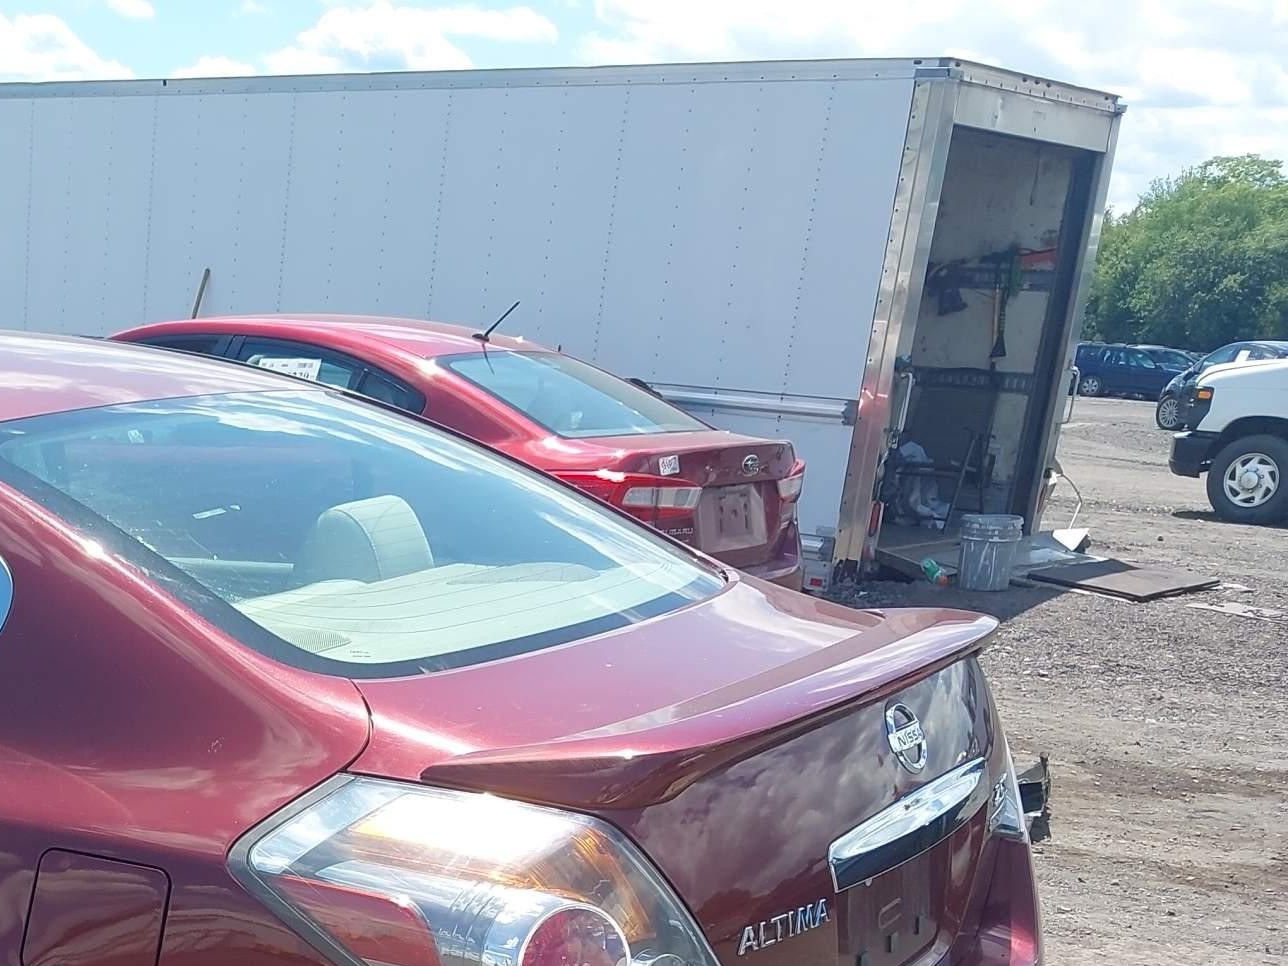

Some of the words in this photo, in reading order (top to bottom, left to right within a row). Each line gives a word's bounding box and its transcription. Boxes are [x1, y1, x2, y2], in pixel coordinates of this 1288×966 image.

[661, 527, 693, 536] UBARU
[897, 727, 925, 746] NISSA
[737, 898, 831, 956] ALTIMA
